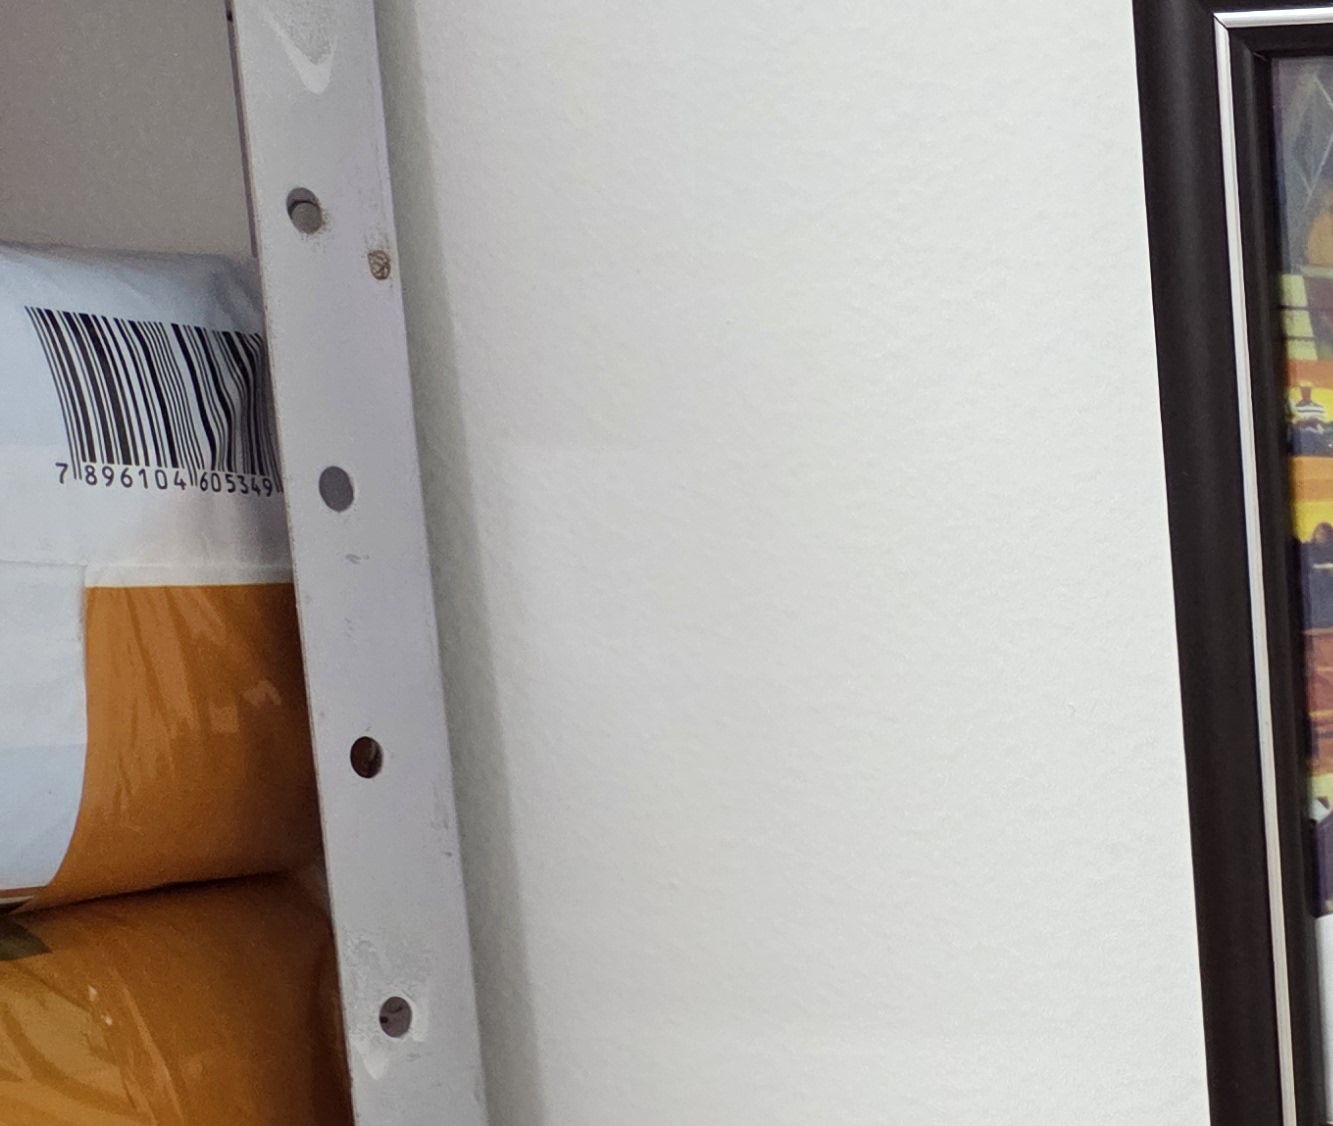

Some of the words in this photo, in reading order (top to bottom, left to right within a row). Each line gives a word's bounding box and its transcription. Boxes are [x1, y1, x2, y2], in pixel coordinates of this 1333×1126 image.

[55, 462, 69, 484] 7
[84, 465, 187, 490] 896104
[200, 473, 273, 497] 605349
